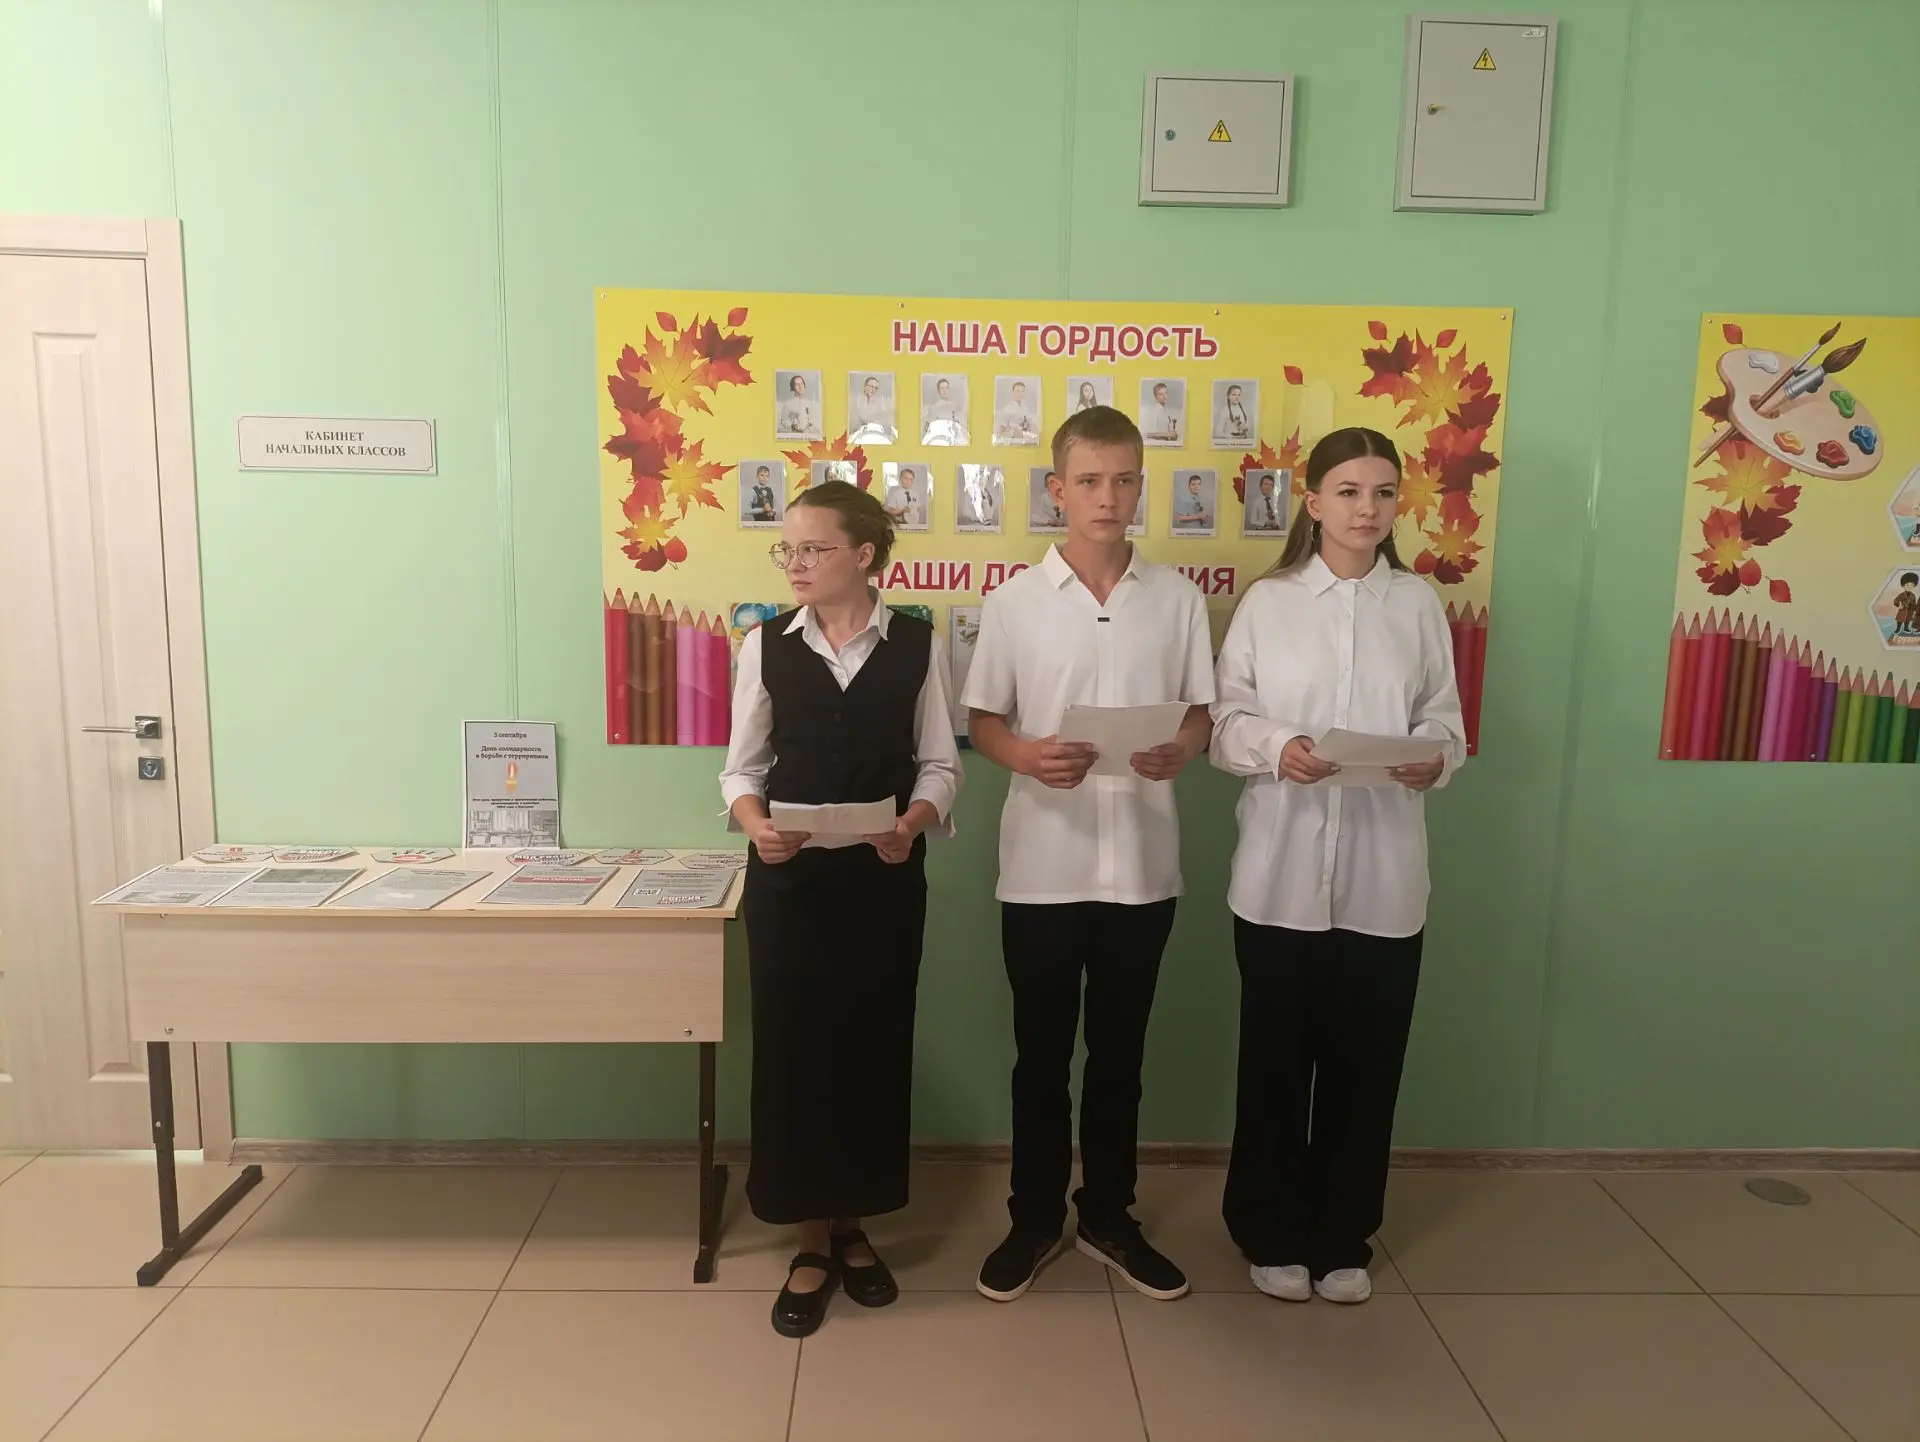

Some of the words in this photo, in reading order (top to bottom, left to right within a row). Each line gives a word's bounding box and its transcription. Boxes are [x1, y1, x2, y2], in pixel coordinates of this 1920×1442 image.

[893, 321, 1007, 354] НАША
[1019, 324, 1218, 362] ГОРДОСТЬ
[305, 431, 364, 441] КАБИНЕТ
[266, 444, 344, 455] НАЧАЛЬНЫХ
[347, 446, 406, 456] КЛАССОВ
